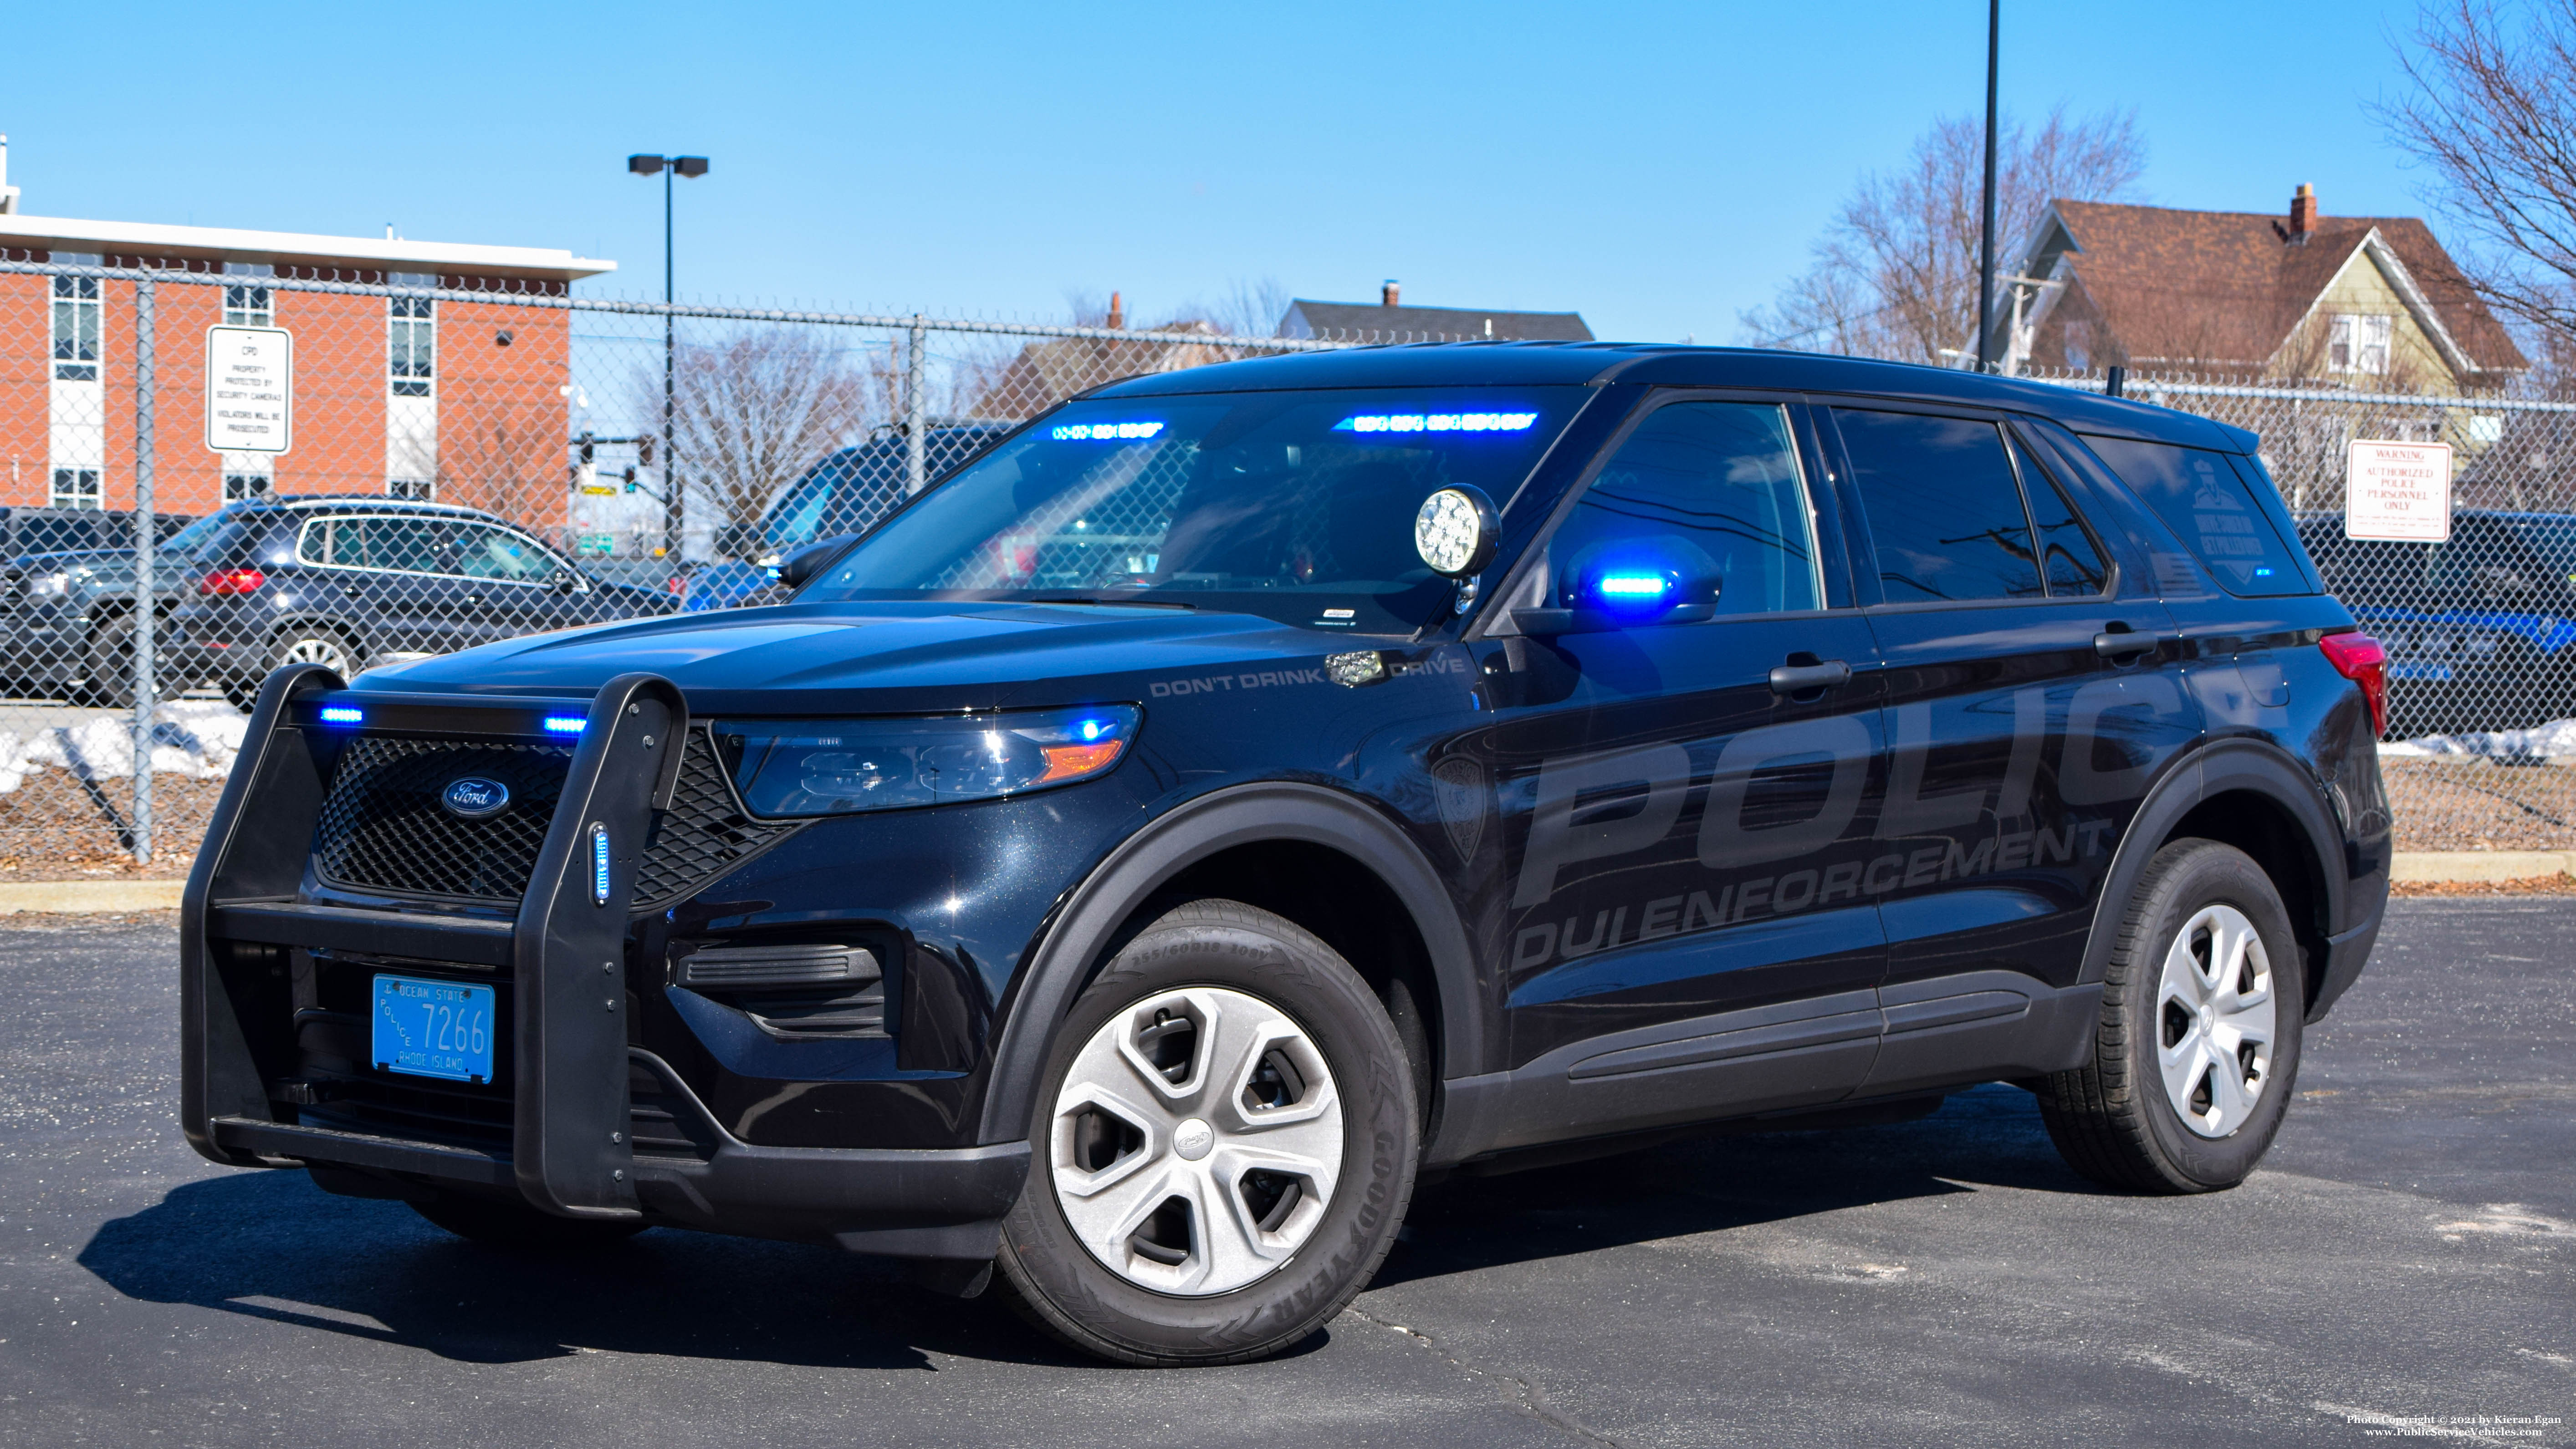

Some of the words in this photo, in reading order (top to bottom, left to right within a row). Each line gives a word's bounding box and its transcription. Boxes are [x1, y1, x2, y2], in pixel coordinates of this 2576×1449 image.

[232, 365, 266, 373] PROPERTY
[225, 377, 261, 386] PROTECTED
[217, 391, 247, 399] SECURITY
[251, 393, 281, 401] CAMERAS
[217, 410, 252, 419] VIOLATORS
[255, 412, 269, 420] WILL
[227, 424, 270, 433] PROSECUTED
[2376, 449, 2424, 460] WARNING
[2367, 467, 2433, 478] AUTHORIZED
[2381, 479, 2416, 489] POLICE
[2367, 490, 2428, 500] PERSONNEL
[2384, 501, 2411, 510] ONLY
[1150, 675, 1235, 697] DON'T
[1239, 668, 1326, 689] DRINK
[1389, 658, 1465, 678] DRIVE
[454, 782, 491, 805] Ford
[1511, 906, 1628, 972] DUI
[1639, 818, 2113, 941] ENFORCEMENT
[399, 985, 429, 999] OCEAN
[436, 989, 465, 1003] STATE
[380, 999, 411, 1047] POLICE
[423, 1004, 484, 1054] 7266
[399, 1051, 426, 1066] RHODE
[432, 1055, 463, 1071] ISLAND
